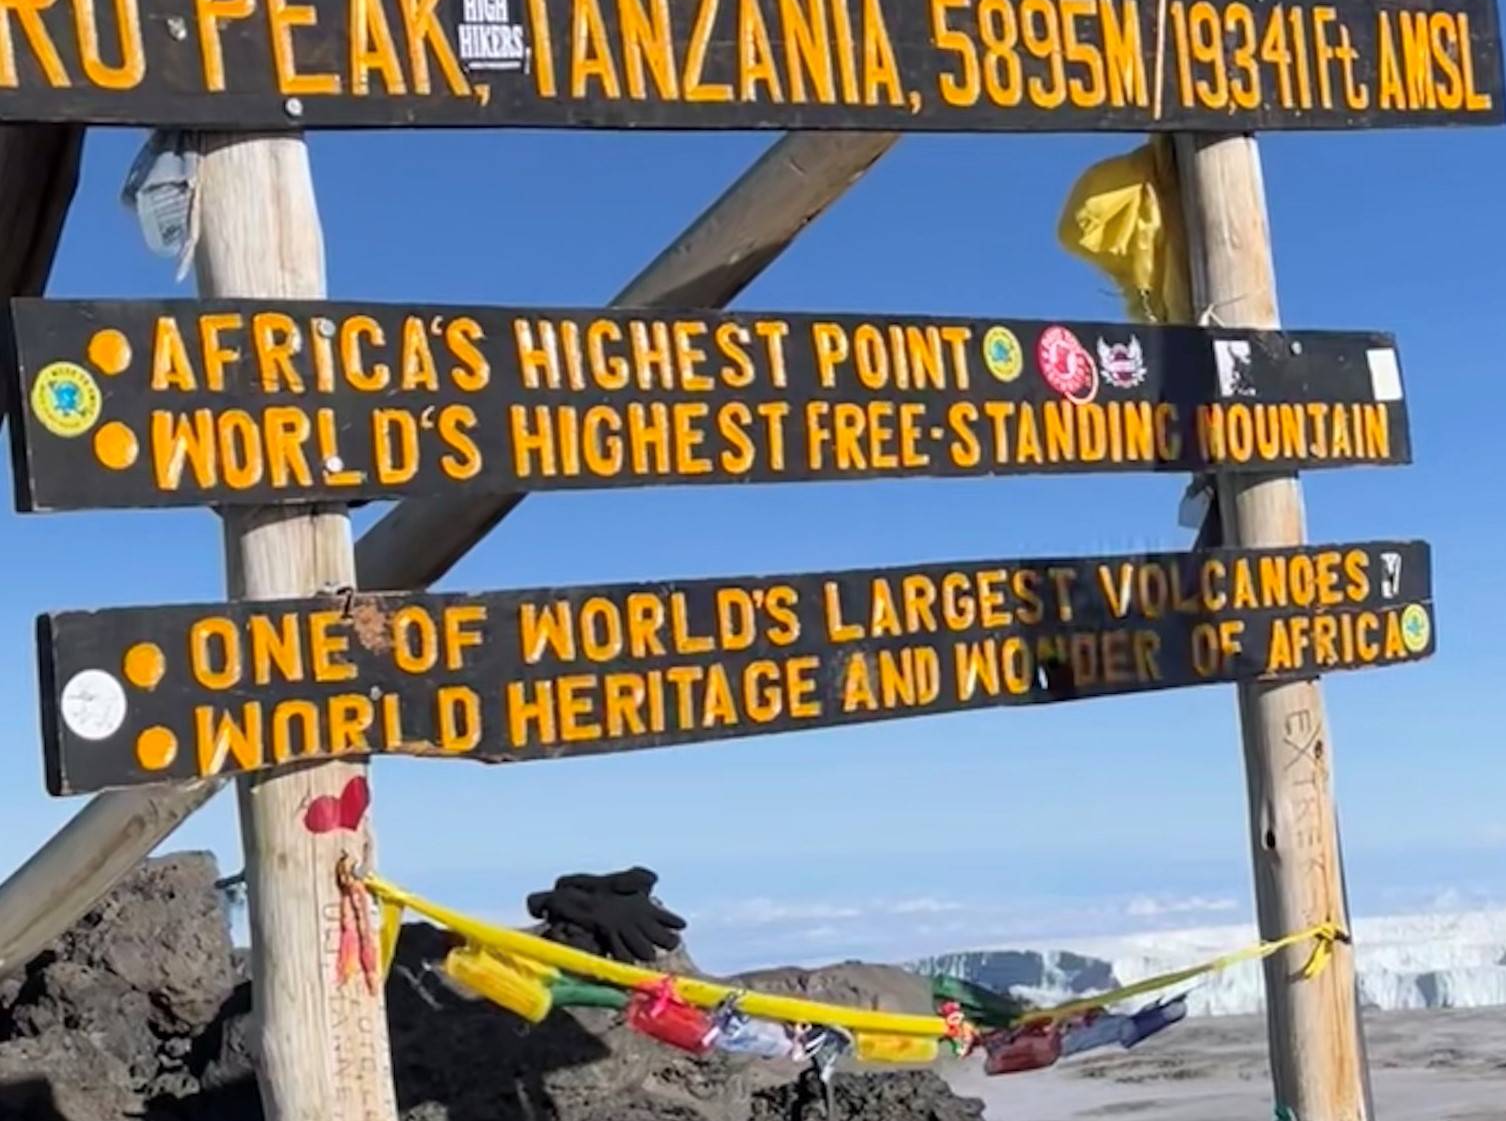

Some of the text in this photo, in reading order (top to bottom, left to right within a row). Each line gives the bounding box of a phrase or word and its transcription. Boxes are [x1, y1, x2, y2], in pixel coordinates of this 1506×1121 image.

[457, 23, 524, 59] HIKERS
[1379, 9, 1493, 112] AMSL
[151, 312, 490, 394] AFRICA'S
[512, 317, 790, 392] HIGHEST
[811, 323, 972, 391] POINT
[150, 400, 1392, 491] WORLD'S HIGHEST FREE-STANDING MOUNTAIN
[189, 550, 1371, 691] ONE OF WORLD'S LARGEST VOLCANOES
[506, 656, 821, 747] HERITAGE
[842, 647, 940, 713] AND
[1193, 618, 1245, 677] OF
[1268, 610, 1409, 675] AFRICA
